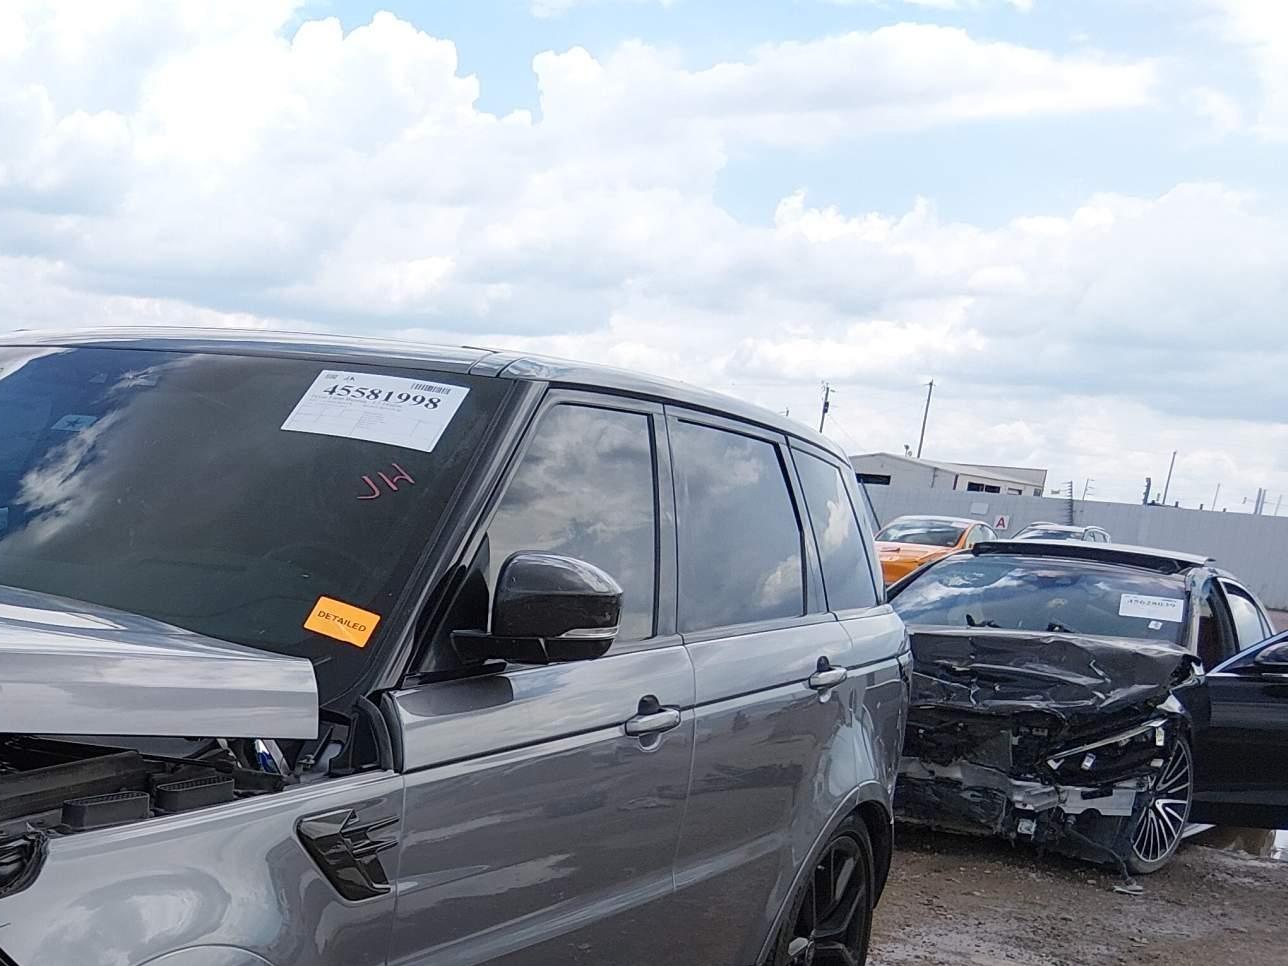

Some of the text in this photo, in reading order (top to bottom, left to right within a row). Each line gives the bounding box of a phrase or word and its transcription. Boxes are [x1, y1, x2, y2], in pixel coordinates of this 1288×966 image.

[323, 384, 441, 410] 45581998
[995, 516, 1006, 529] A
[317, 610, 367, 632] DETAILED
